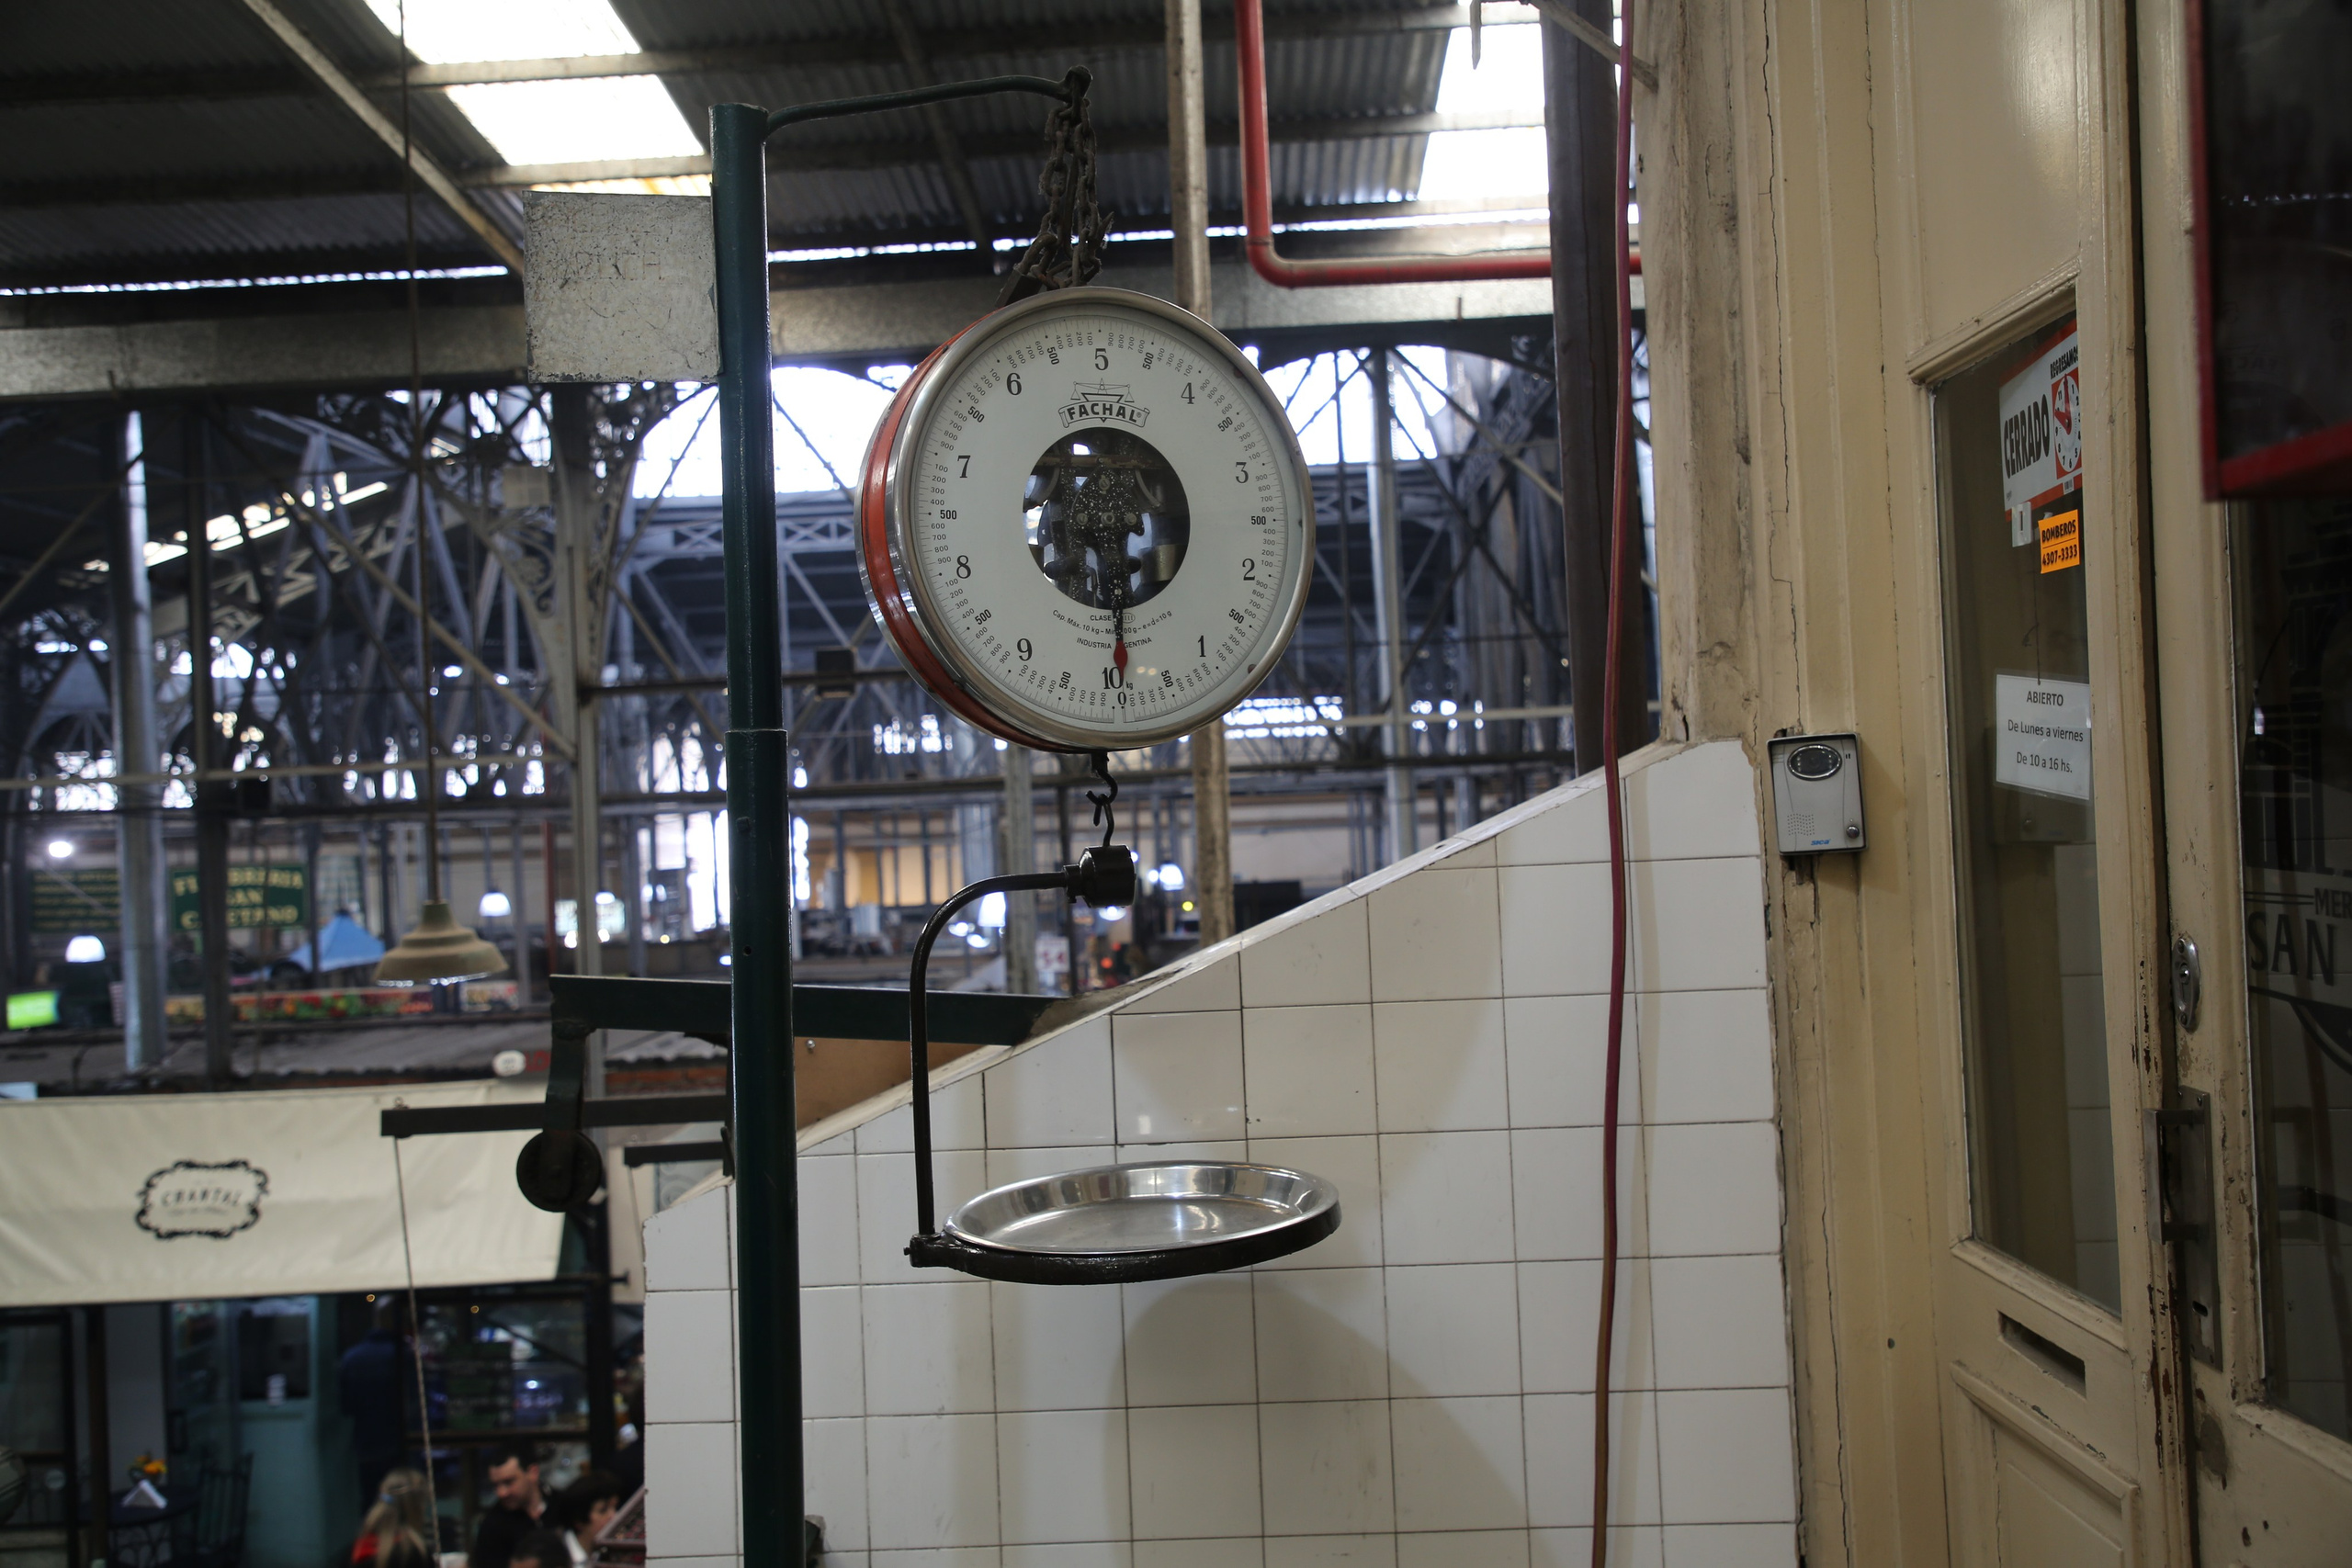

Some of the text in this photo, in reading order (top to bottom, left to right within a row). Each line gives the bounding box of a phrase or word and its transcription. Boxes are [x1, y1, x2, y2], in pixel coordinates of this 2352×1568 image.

[1025, 345, 1035, 359] 700
[1035, 341, 1044, 355] 600
[1157, 348, 1165, 362] 400
[1007, 355, 1017, 368] 900
[1015, 349, 1025, 364] 800
[1047, 346, 1059, 365] 500
[1095, 348, 1109, 371] 5
[1142, 352, 1154, 370] 500
[1166, 353, 1174, 367] 300
[1174, 358, 1183, 373] 200
[1183, 365, 1193, 377] 100
[980, 375, 993, 389] 200
[989, 368, 1001, 382] 100
[973, 382, 986, 396] 300
[1006, 373, 1022, 395] 6
[1200, 378, 1210, 391] 900
[967, 391, 979, 404] 400
[1181, 382, 1195, 404] 4
[1207, 386, 1218, 400] 800
[1214, 394, 1226, 407] 700
[967, 406, 985, 423] 500
[1221, 403, 1233, 415] 600
[954, 411, 967, 423] 600
[1217, 416, 1233, 432] 500
[949, 420, 963, 432] 700
[1233, 422, 1246, 433] 400
[944, 430, 958, 441] 800
[1238, 432, 1251, 442] 300
[2004, 394, 2050, 479] CERRADO
[940, 441, 955, 451] 900
[1243, 442, 1256, 452] 200
[1249, 452, 1261, 461] 100
[935, 464, 948, 472] 100
[957, 455, 971, 479] 7
[1236, 462, 1249, 483] 3
[932, 475, 946, 483] 200
[1258, 484, 1271, 492] 800
[940, 510, 957, 520] 500
[1251, 516, 1266, 525] 500
[2041, 520, 2076, 543] BOMBEROS
[934, 545, 948, 553] 800
[2042, 544, 2078, 566] 4307-3333
[956, 555, 971, 579] 8
[1242, 558, 1256, 581] 2
[1261, 559, 1272, 568] 100
[945, 578, 958, 588] 100
[1255, 580, 1268, 590] 900
[949, 588, 964, 599] 200
[1251, 589, 1264, 599] 800
[956, 598, 968, 610] 300
[1249, 599, 1261, 609] 700
[962, 608, 975, 619] 400
[974, 609, 992, 625] 500
[1228, 608, 1244, 625] 500
[1244, 608, 1257, 619] 600
[1053, 610, 1066, 621] Cap.
[1091, 626, 1099, 635] kg
[975, 626, 988, 639] 600
[1234, 626, 1246, 637] 400
[982, 635, 995, 648] 700
[1077, 637, 1152, 649] INDUSTRIA GENTINA
[1197, 635, 1206, 658] 1
[1228, 634, 1240, 647] 300
[990, 643, 1002, 657] 800
[1016, 638, 1033, 661] 9
[1216, 649, 1226, 661] 100
[1222, 641, 1234, 655] 200
[1000, 650, 1011, 664] 900
[1018, 664, 1029, 678] 100
[1193, 668, 1203, 682] 800
[1201, 662, 1211, 676] 900
[1027, 670, 1037, 684] 200
[1036, 675, 1046, 690] 300
[1059, 671, 1071, 690] 500
[1102, 667, 1134, 690] 10 kg
[1160, 670, 1174, 688] 500
[1184, 673, 1194, 687] 700
[1047, 680, 1057, 694] 400
[1176, 677, 1185, 692] 600
[1069, 687, 1077, 702] 600
[1117, 692, 1126, 705] 0
[1158, 686, 1166, 700] 400
[2026, 691, 2064, 706] ABIERTO
[2007, 719, 2084, 742] De Lunes a viernes
[2017, 751, 2073, 773] De 10 a 16 hs.
[2247, 911, 2336, 987] SAN
